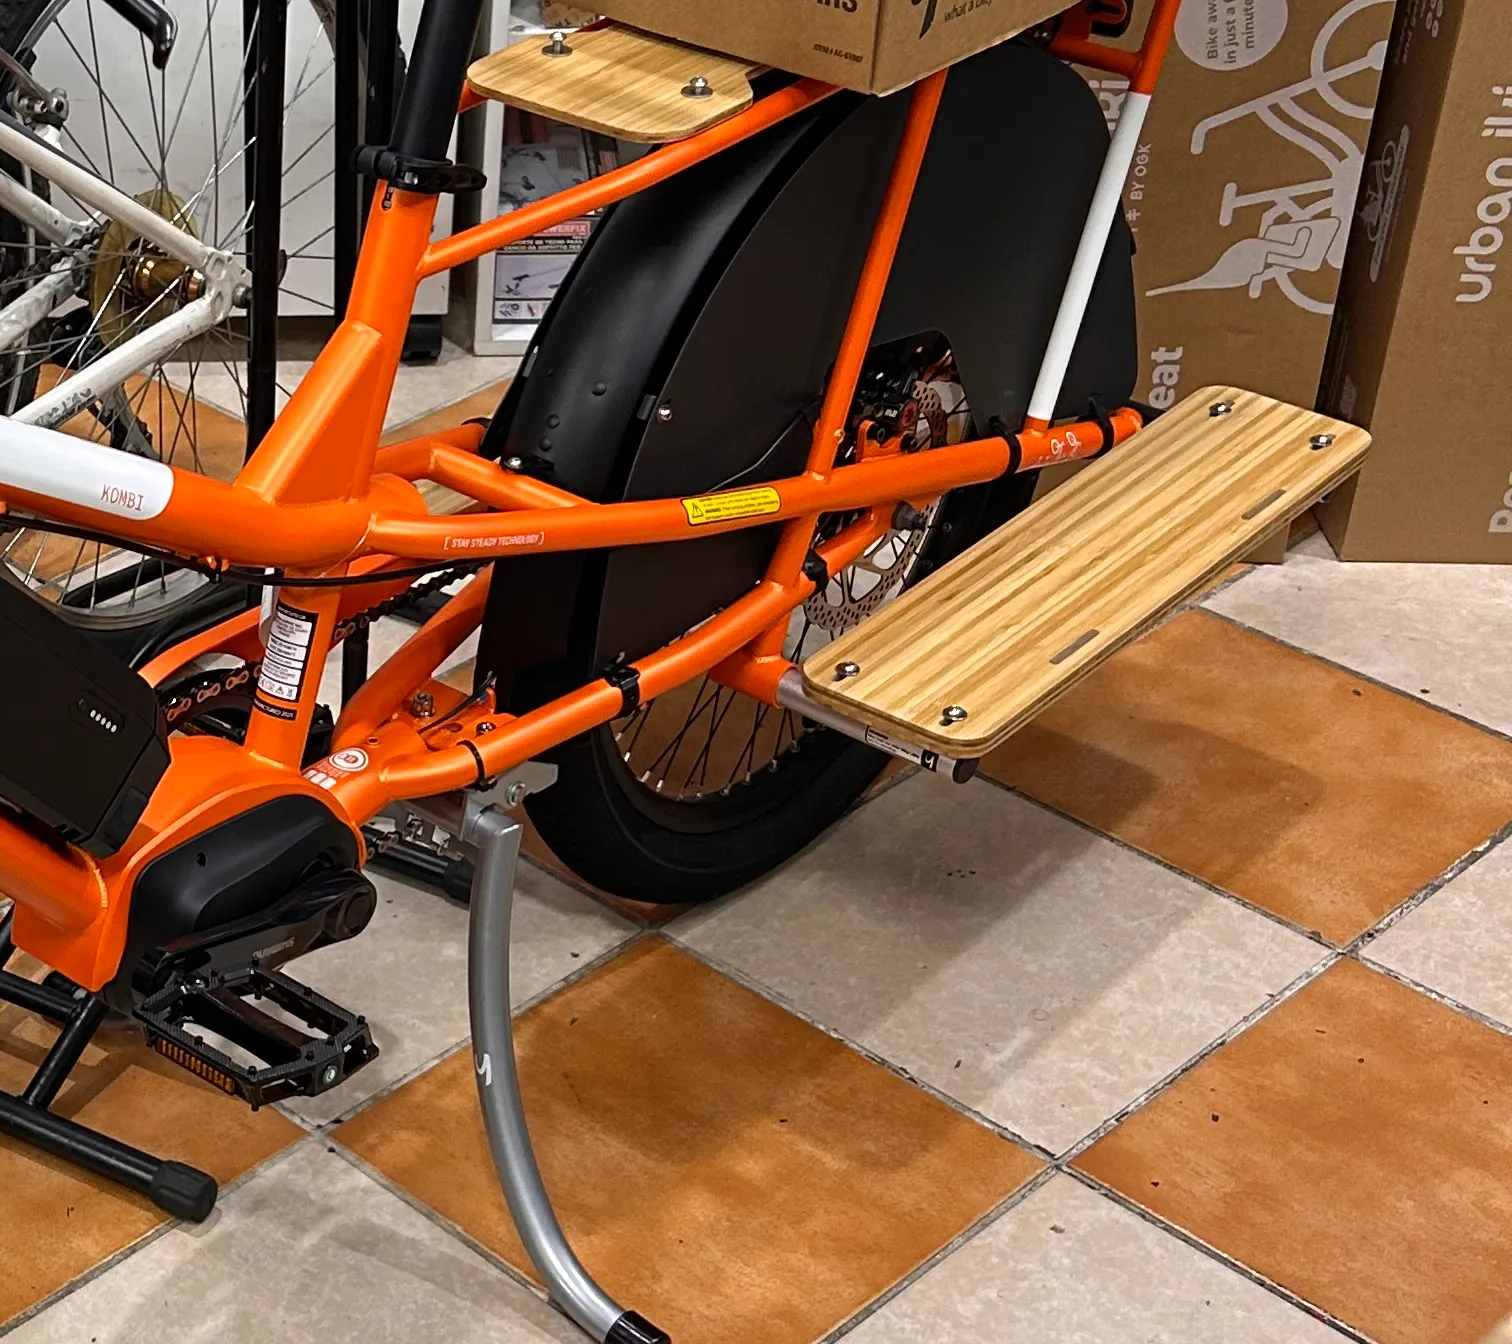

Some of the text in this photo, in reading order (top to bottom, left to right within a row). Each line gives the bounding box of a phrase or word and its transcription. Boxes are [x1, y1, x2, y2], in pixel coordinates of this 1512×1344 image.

[944, 3, 967, 23] what
[1206, 27, 1218, 60] Bike
[1223, 19, 1240, 47] just
[1129, 143, 1152, 201] BY OGK
[1148, 346, 1184, 409] eat
[100, 485, 144, 513] KOMBI
[451, 534, 539, 549] STAY STEADY TECHNOLOGY
